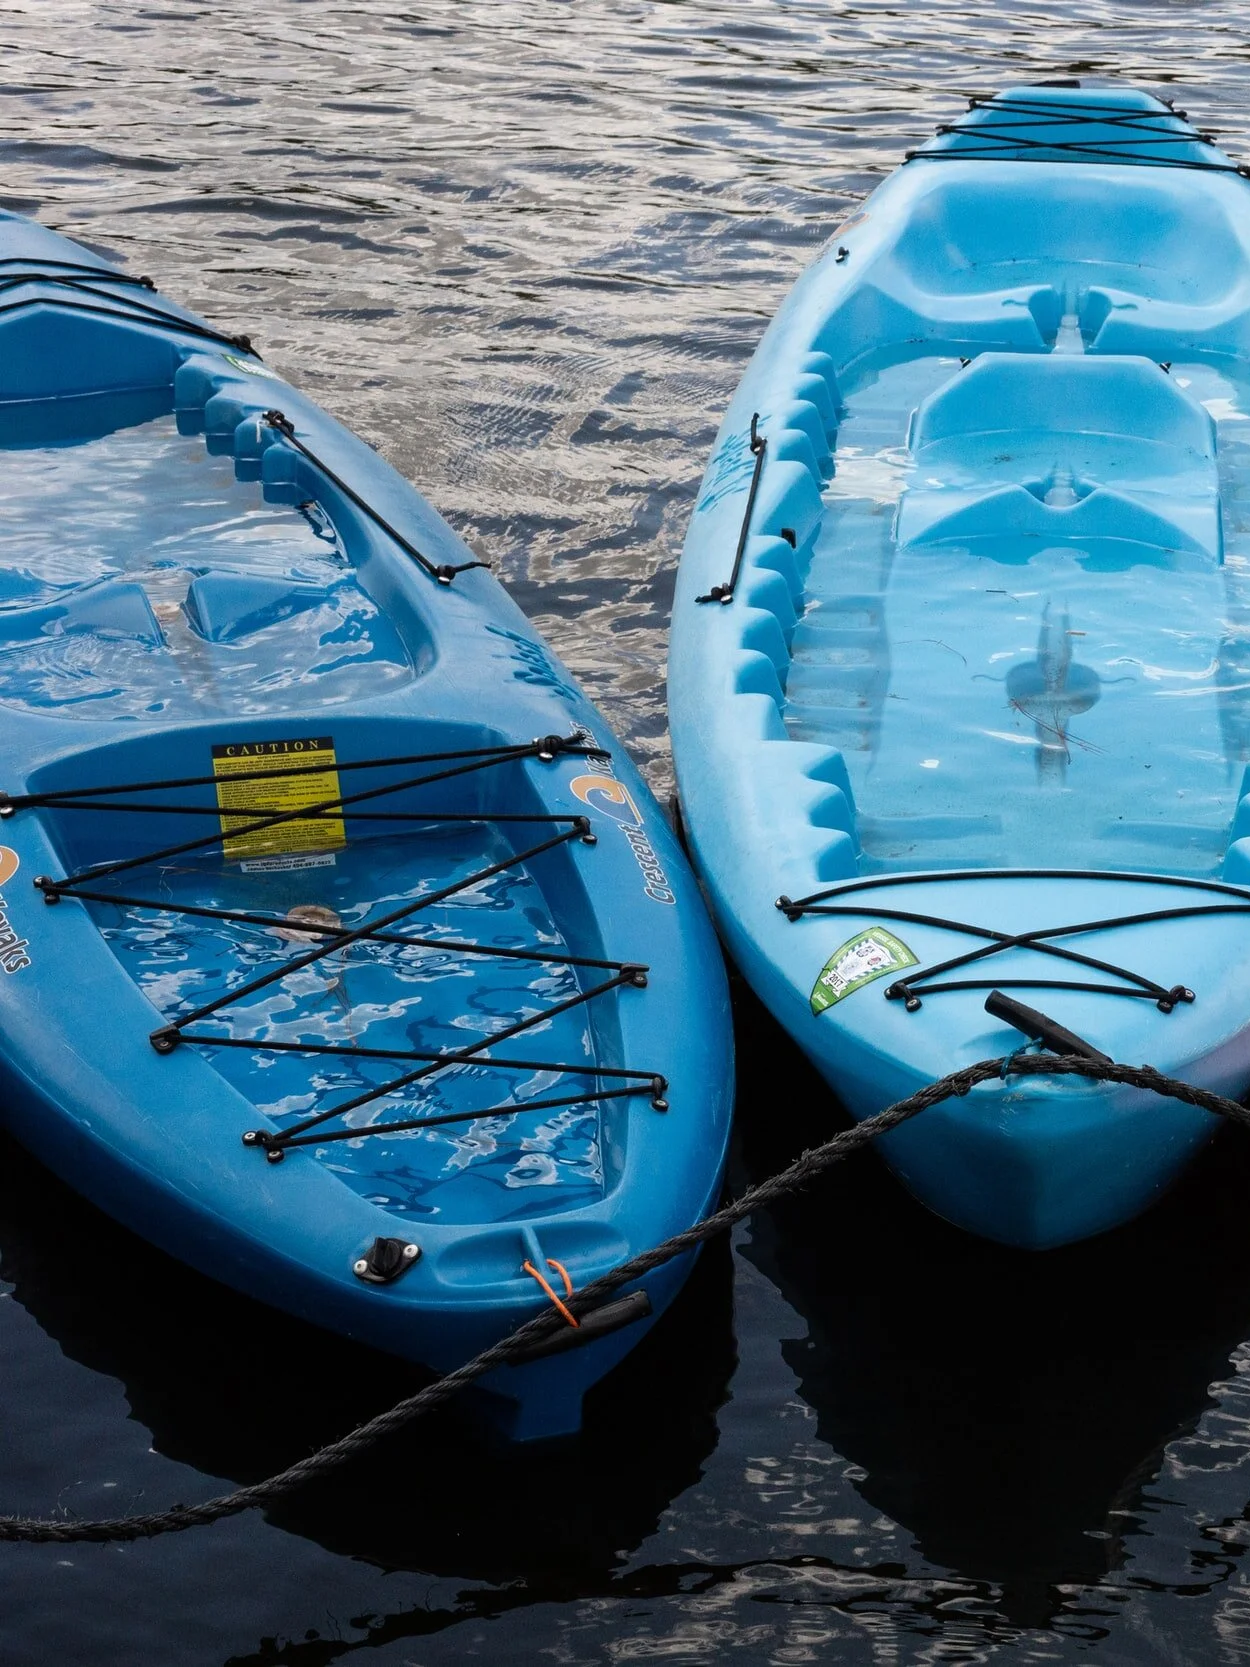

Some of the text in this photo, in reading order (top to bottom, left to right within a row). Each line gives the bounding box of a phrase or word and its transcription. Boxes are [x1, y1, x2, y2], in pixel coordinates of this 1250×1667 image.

[226, 739, 319, 756] CAUTION
[617, 822, 677, 905] Crescent
[828, 973, 844, 987] 2017
